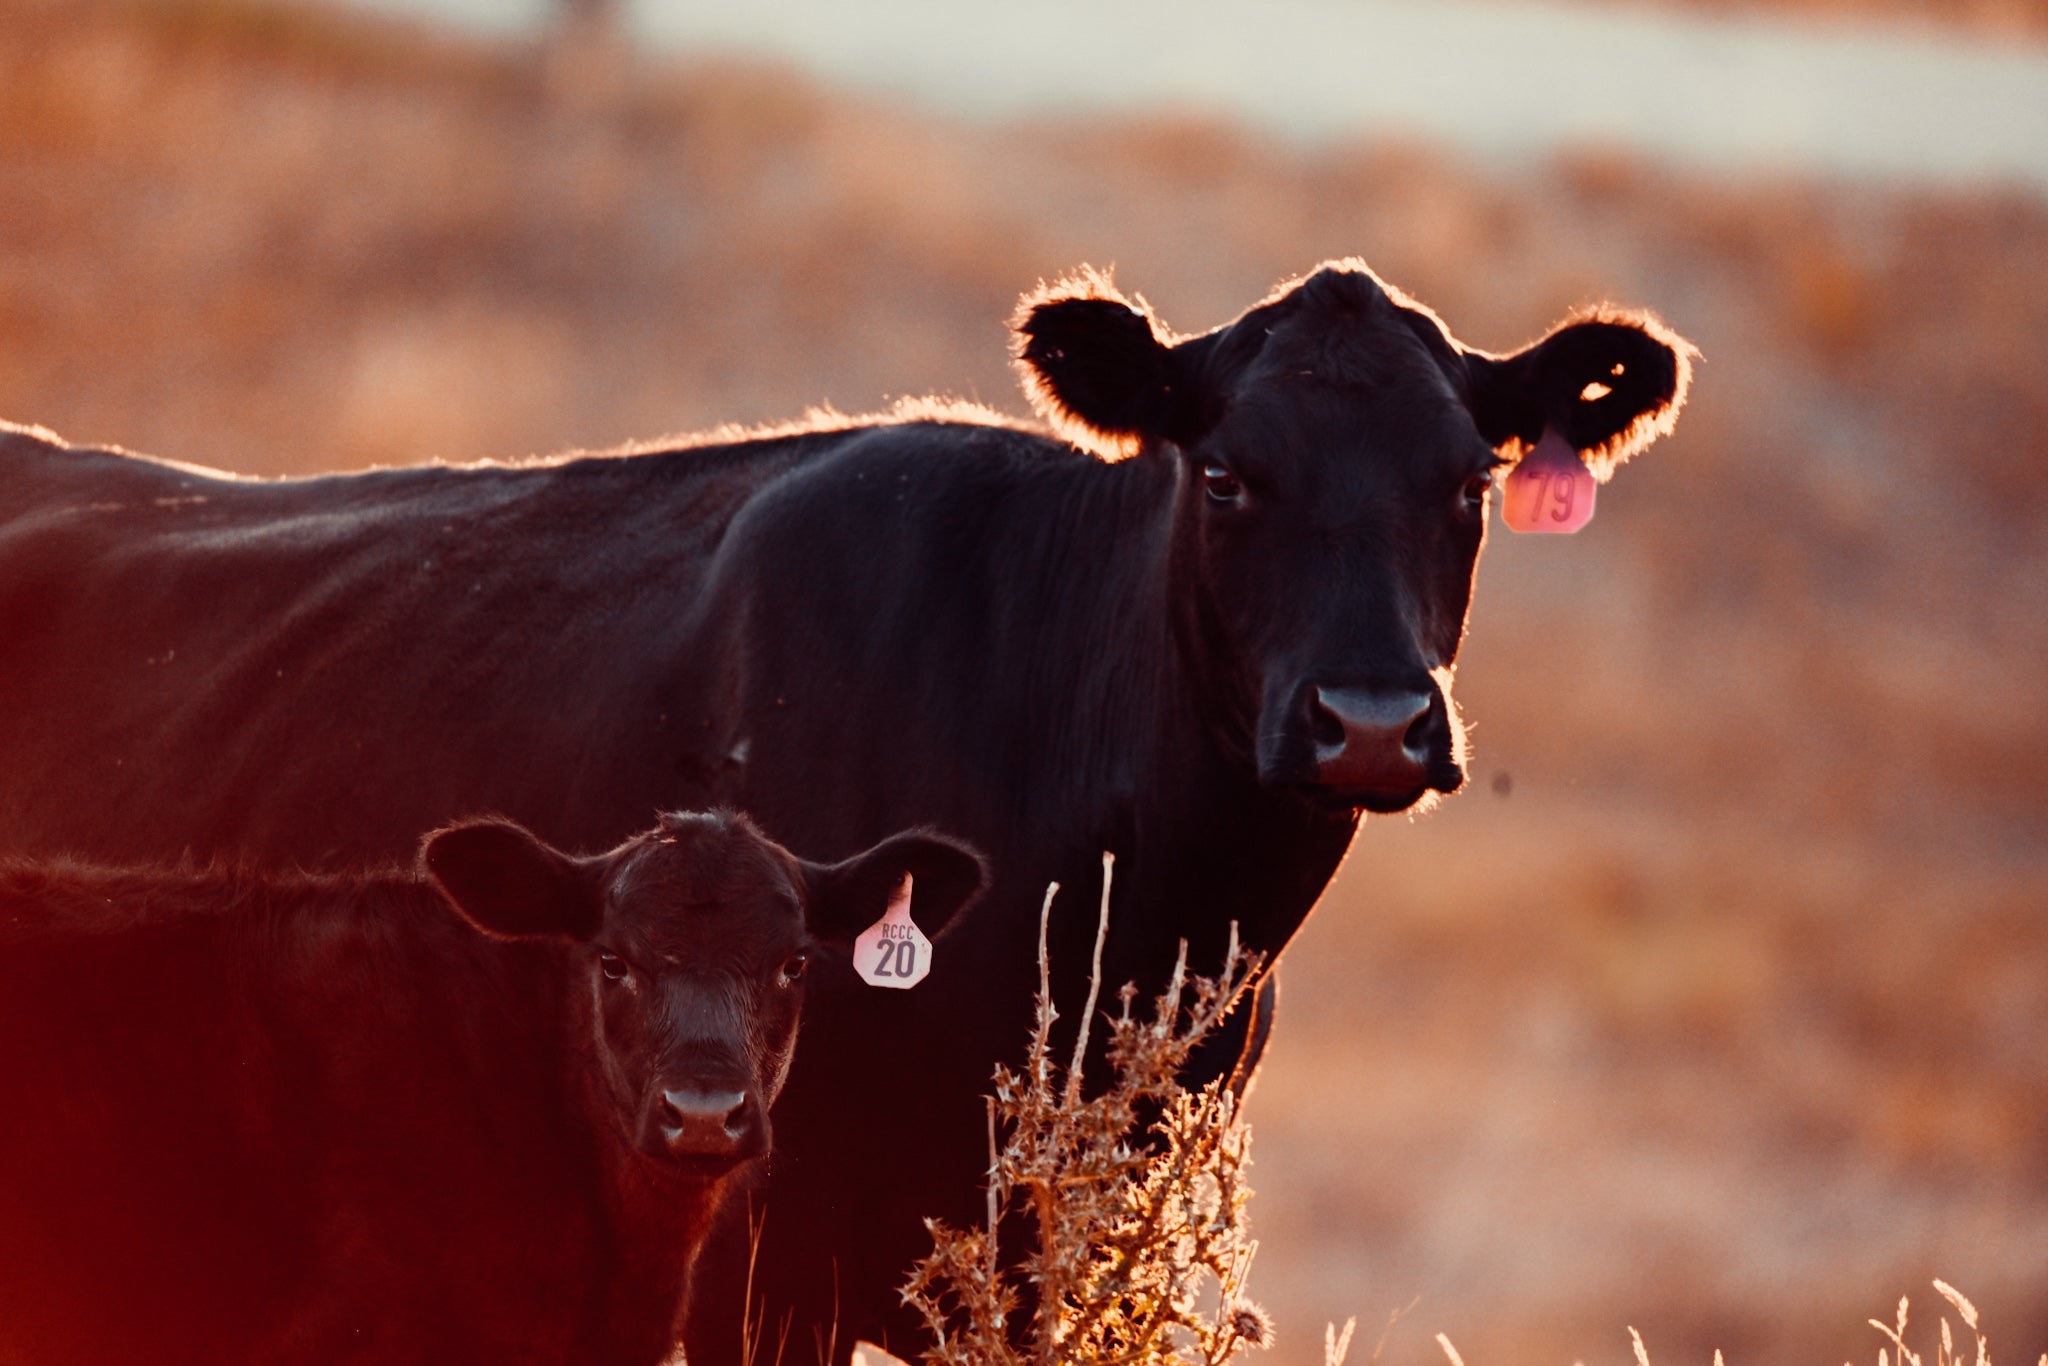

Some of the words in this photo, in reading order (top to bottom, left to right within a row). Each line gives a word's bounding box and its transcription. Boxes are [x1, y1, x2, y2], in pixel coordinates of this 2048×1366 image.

[1528, 471, 1575, 522] 79
[882, 923, 914, 940] RCCC
[874, 939, 916, 978] 20
